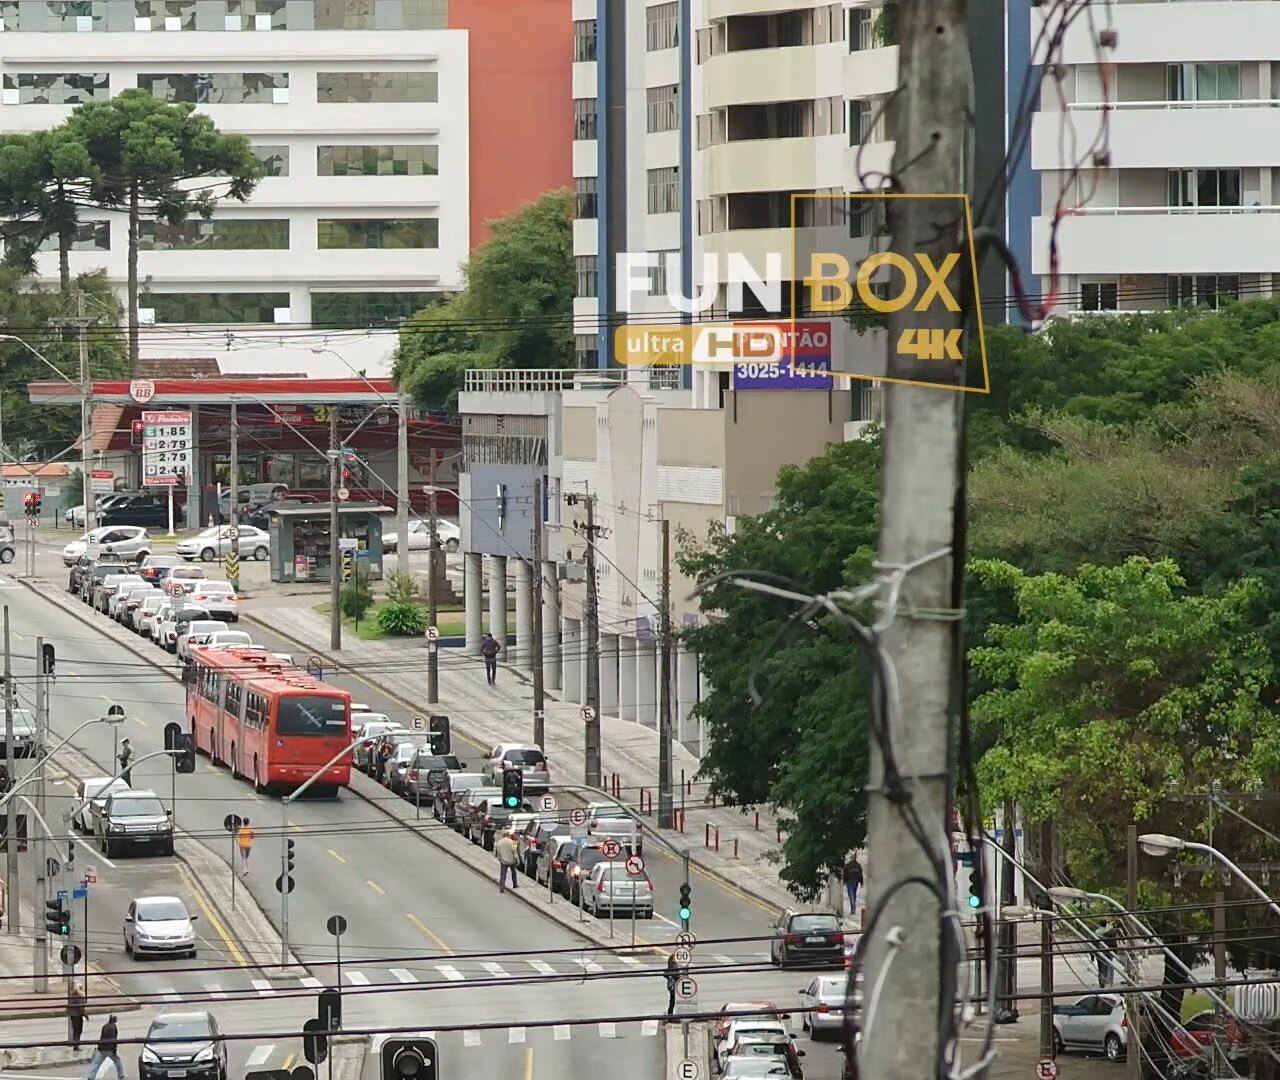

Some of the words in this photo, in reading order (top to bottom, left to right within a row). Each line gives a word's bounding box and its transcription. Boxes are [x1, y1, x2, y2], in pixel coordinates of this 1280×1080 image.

[737, 362, 828, 379] 3025-1414
[159, 426, 186, 436] 1,85
[158, 440, 186, 449] 2,79
[159, 453, 186, 462] 2,79
[414, 718, 422, 728] E
[681, 981, 691, 995] E
[682, 1063, 692, 1078] E
